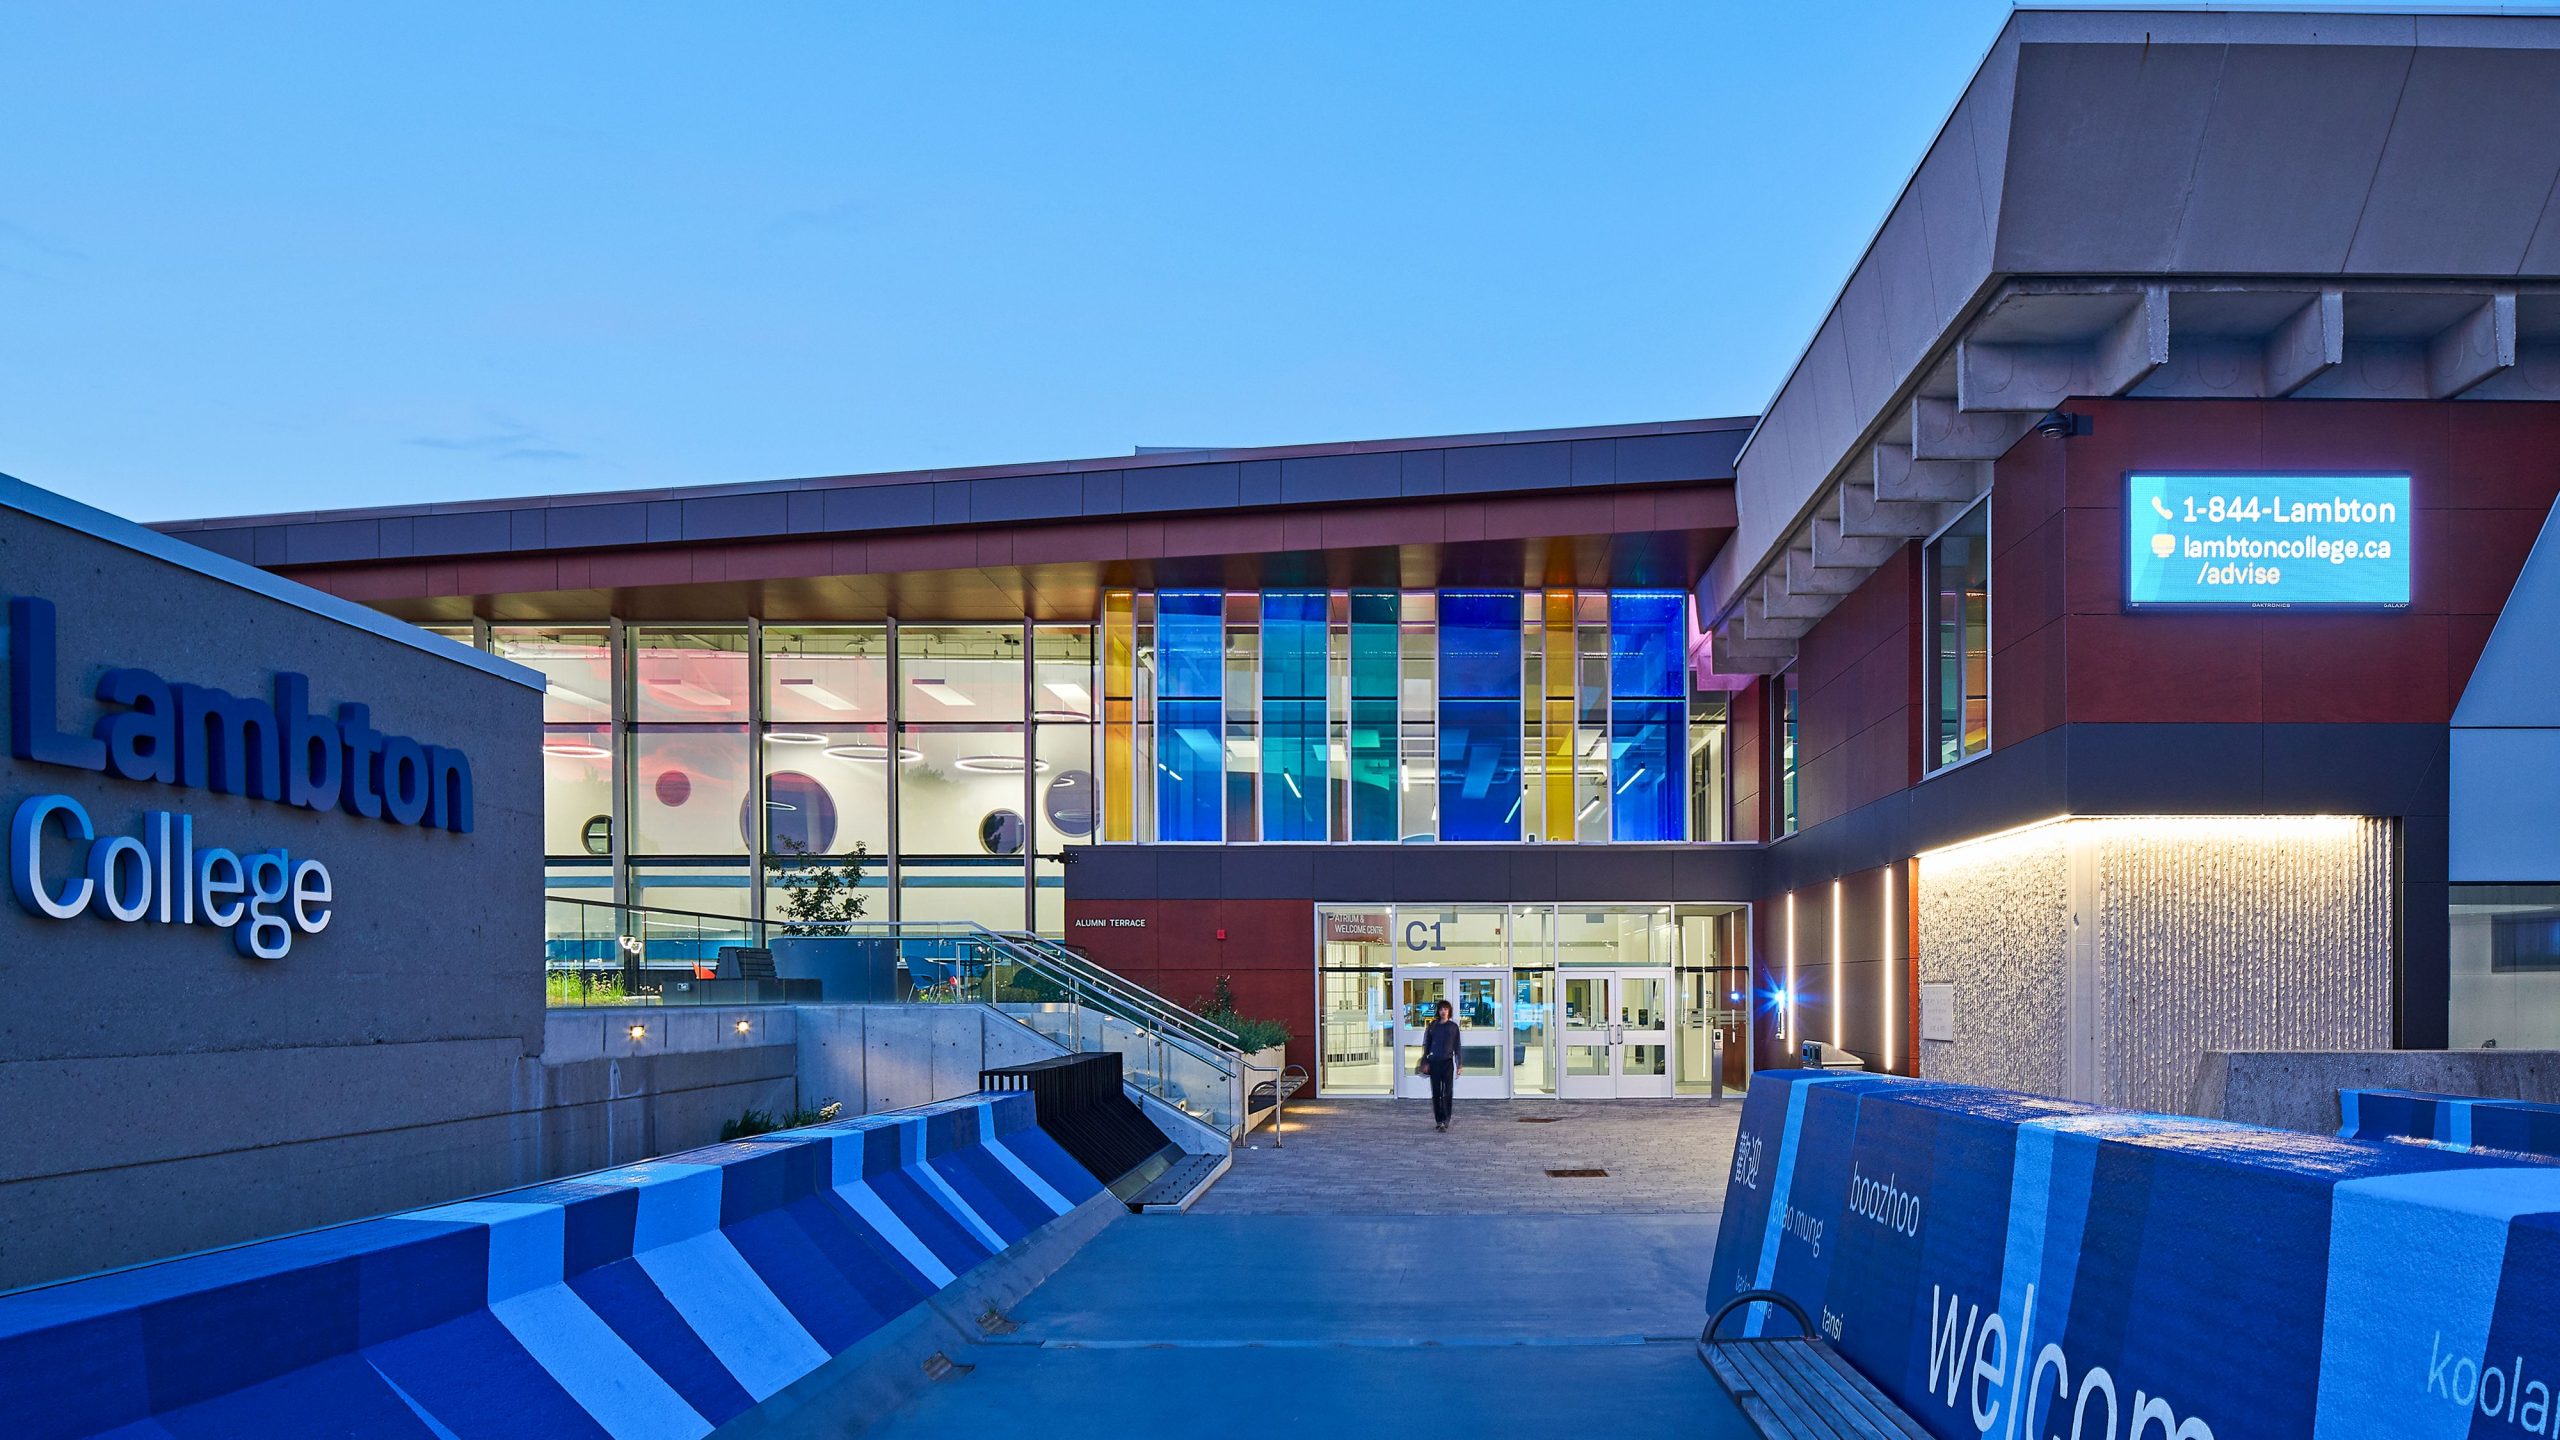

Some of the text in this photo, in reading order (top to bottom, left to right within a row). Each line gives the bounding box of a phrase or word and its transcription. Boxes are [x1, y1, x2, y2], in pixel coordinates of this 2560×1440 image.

[2183, 496, 2396, 523] 1-844-Lambton
[2184, 535, 2392, 564] lambtoncollege.ca
[2197, 562, 2281, 585] /advise
[9, 596, 474, 833] Lambton
[10, 794, 333, 960] College
[1075, 919, 1146, 927] ALUMNI TERRACE
[1334, 913, 1360, 923] ATRIUM
[1334, 924, 1384, 936] WELCOME CENTRE
[1405, 920, 1446, 951] C1
[1849, 1161, 1920, 1238] boozhoo
[1793, 1210, 1824, 1259] mung
[1822, 1304, 1844, 1342] tansi
[2426, 1329, 2560, 1440] koola
